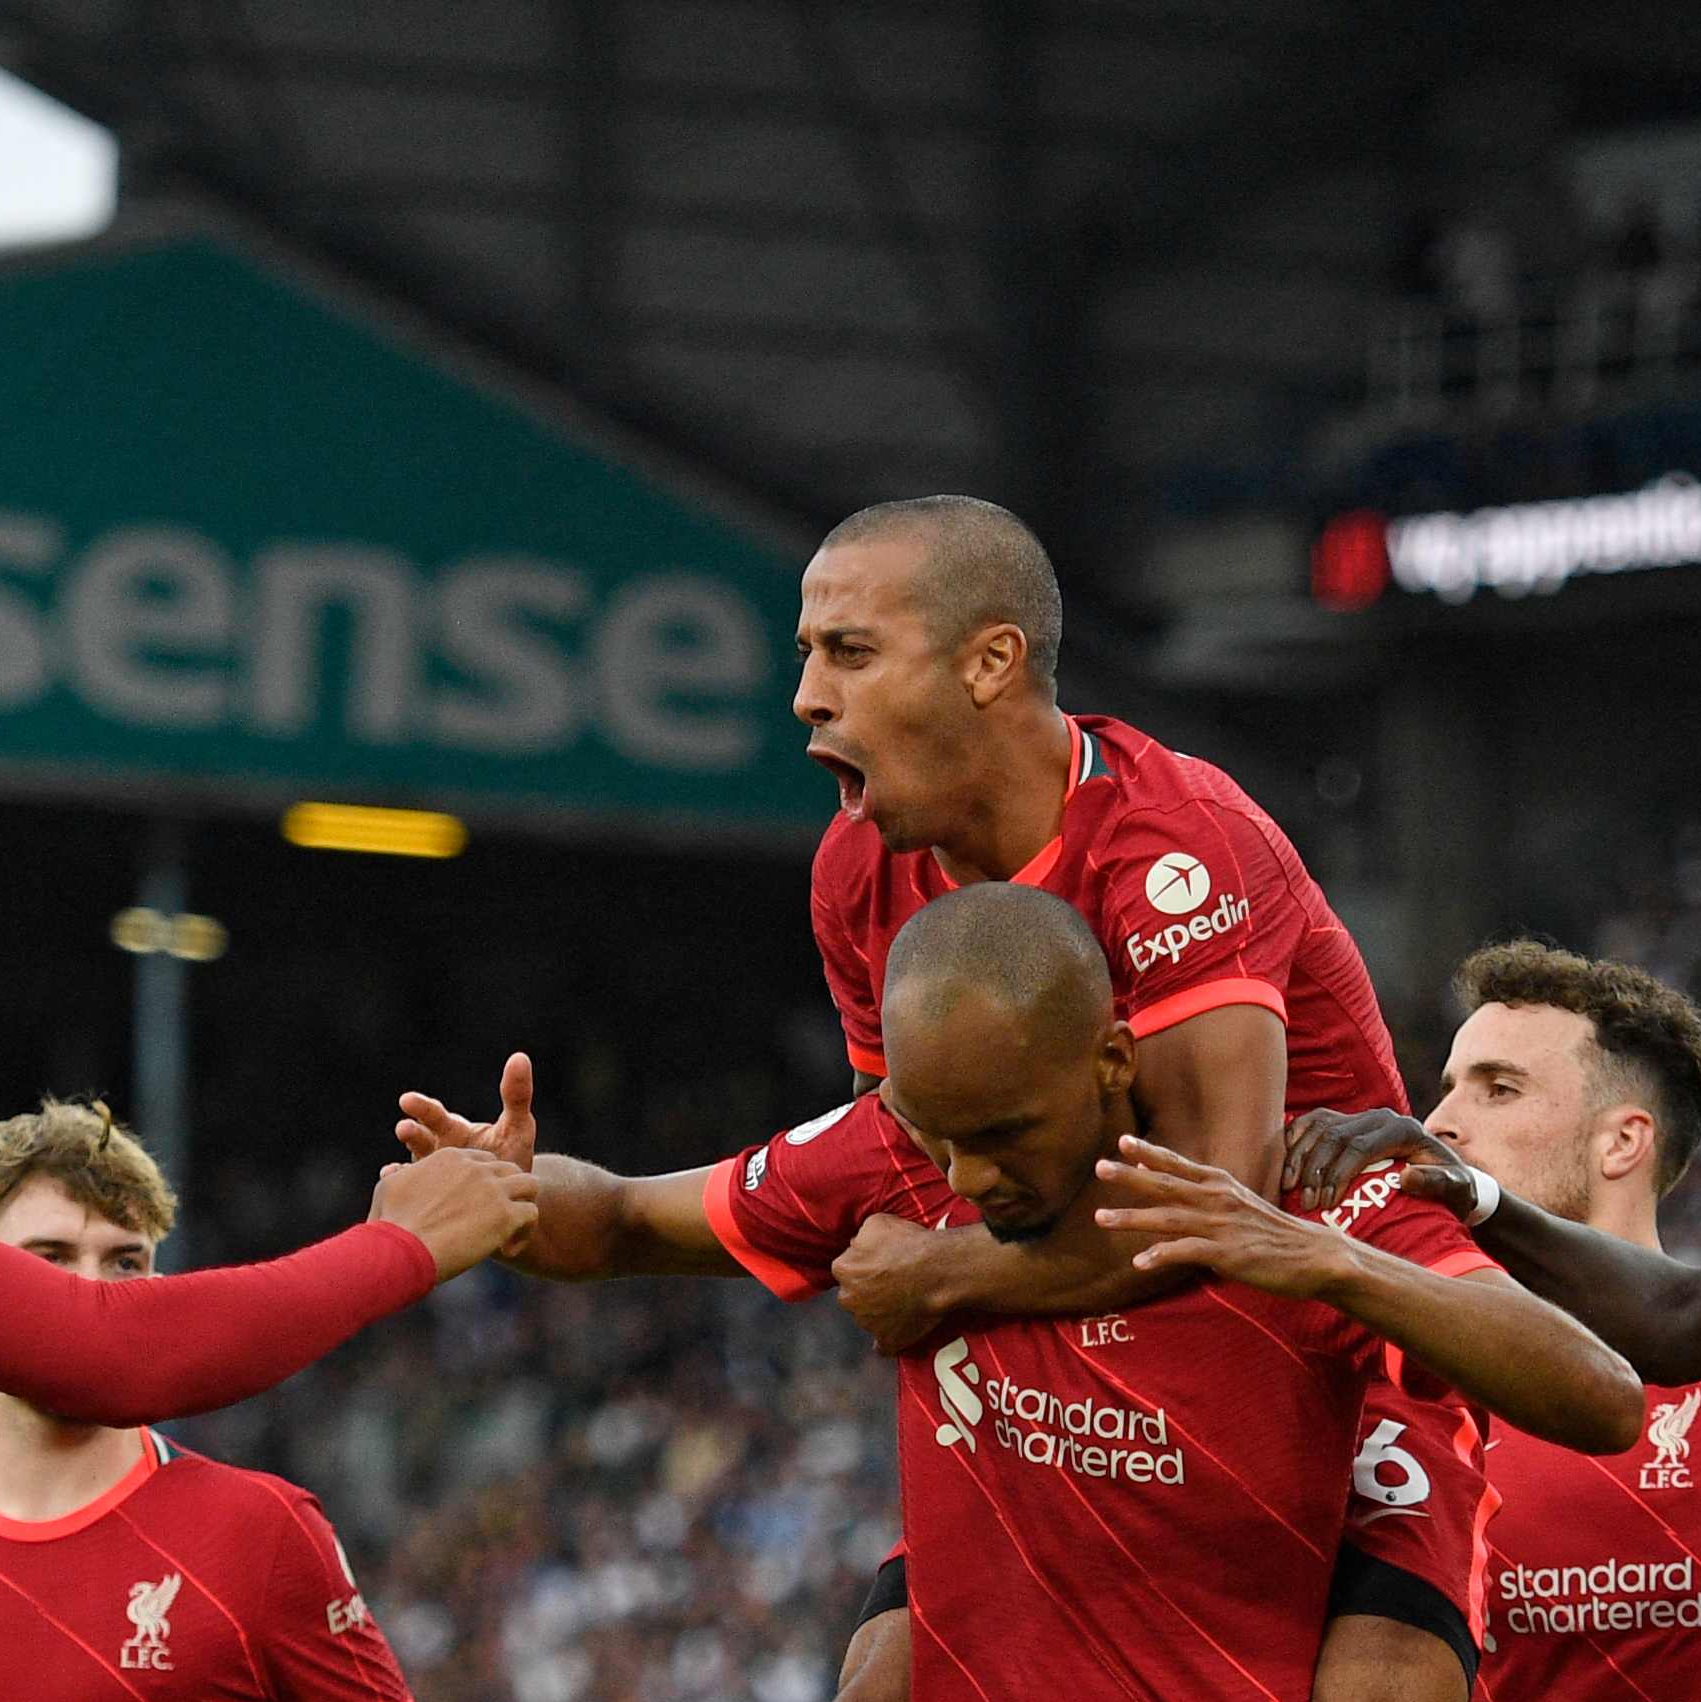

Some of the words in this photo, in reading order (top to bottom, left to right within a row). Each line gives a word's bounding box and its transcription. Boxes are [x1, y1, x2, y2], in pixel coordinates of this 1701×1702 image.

[1321, 1172, 1401, 1233] Expe
[986, 1376, 1168, 1446] standard
[995, 1417, 1185, 1485] chartered
[1352, 1418, 1431, 1507] 6
[1499, 1556, 1693, 1601] standard
